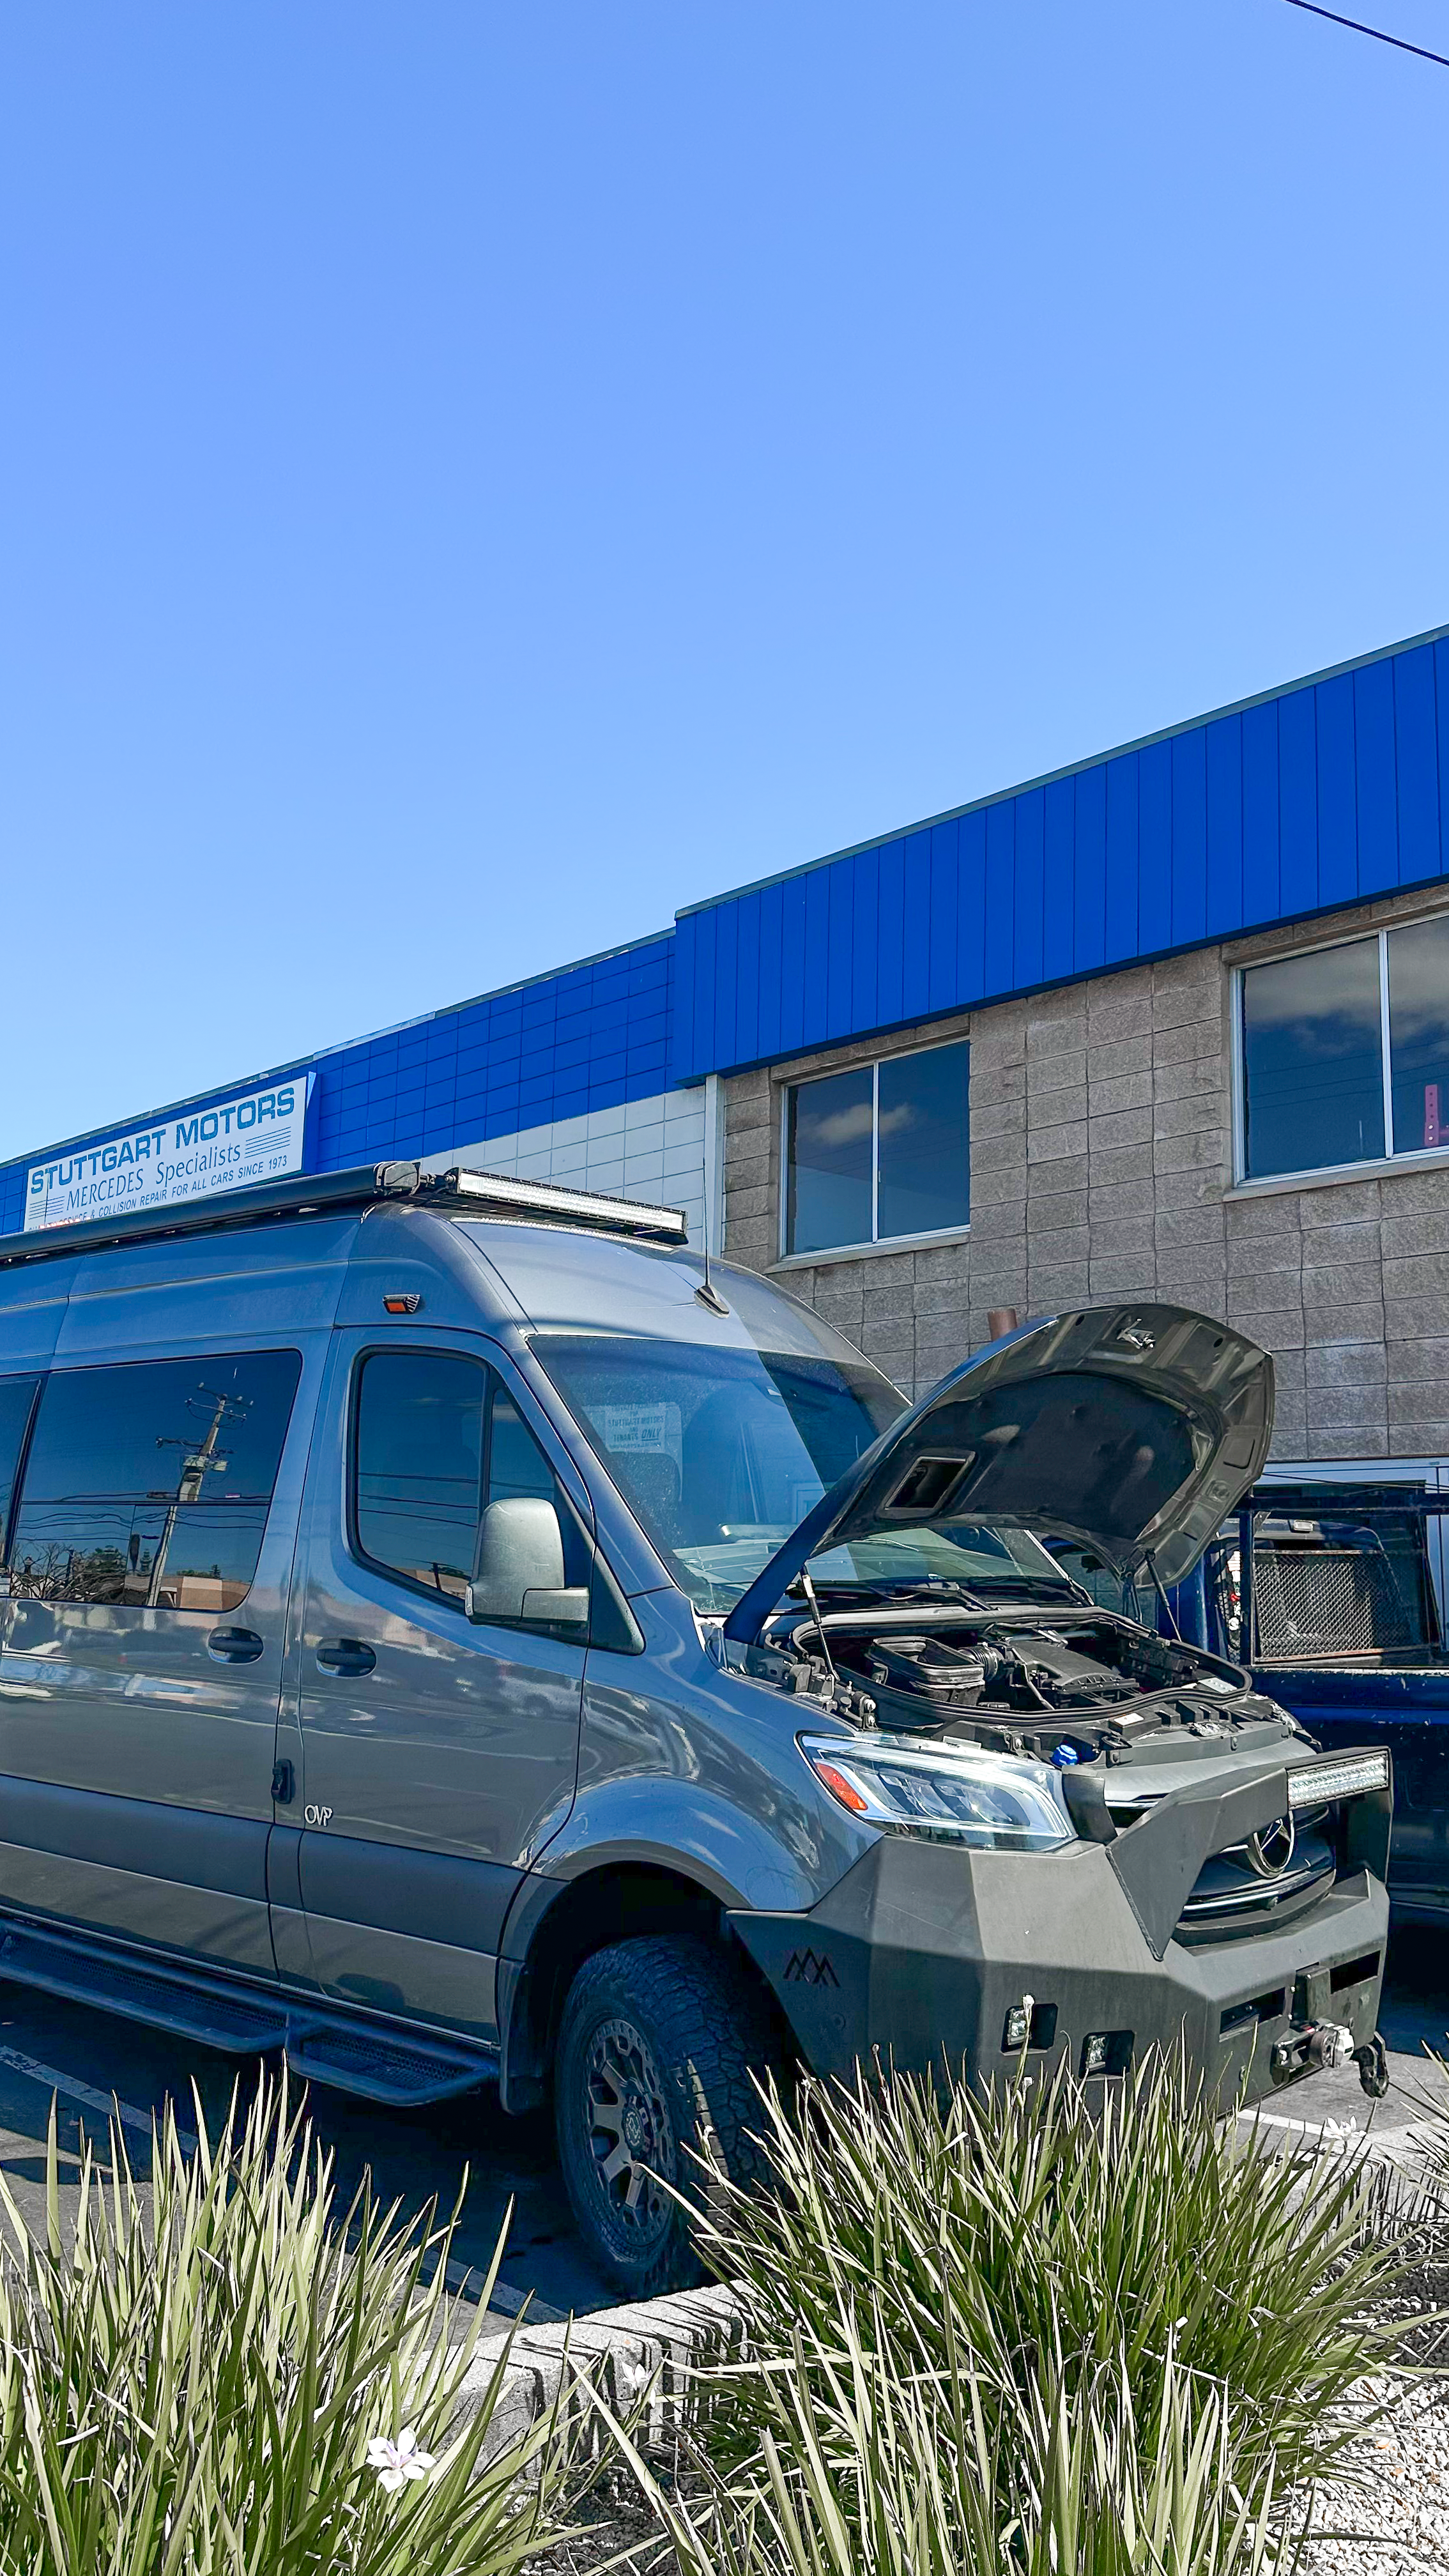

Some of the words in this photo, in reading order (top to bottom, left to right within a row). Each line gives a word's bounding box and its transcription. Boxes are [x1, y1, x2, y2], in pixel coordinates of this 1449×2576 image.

[31, 1128, 166, 1194] STUTTGART
[176, 1087, 295, 1149] MOTORS
[59, 1211, 88, 1224] RVICE
[90, 1209, 95, 1219] &
[98, 1198, 137, 1218] COLLISION
[139, 1189, 167, 1207] REPAIR
[171, 1183, 188, 1198] FOR
[191, 1178, 207, 1193] ALL
[211, 1170, 234, 1186] CARS
[238, 1161, 264, 1179] SINCE
[268, 1154, 288, 1170] 1973
[66, 1168, 144, 1211] MERCEDES
[156, 1142, 241, 1188] Specialists
[641, 1427, 662, 1439] ONLY
